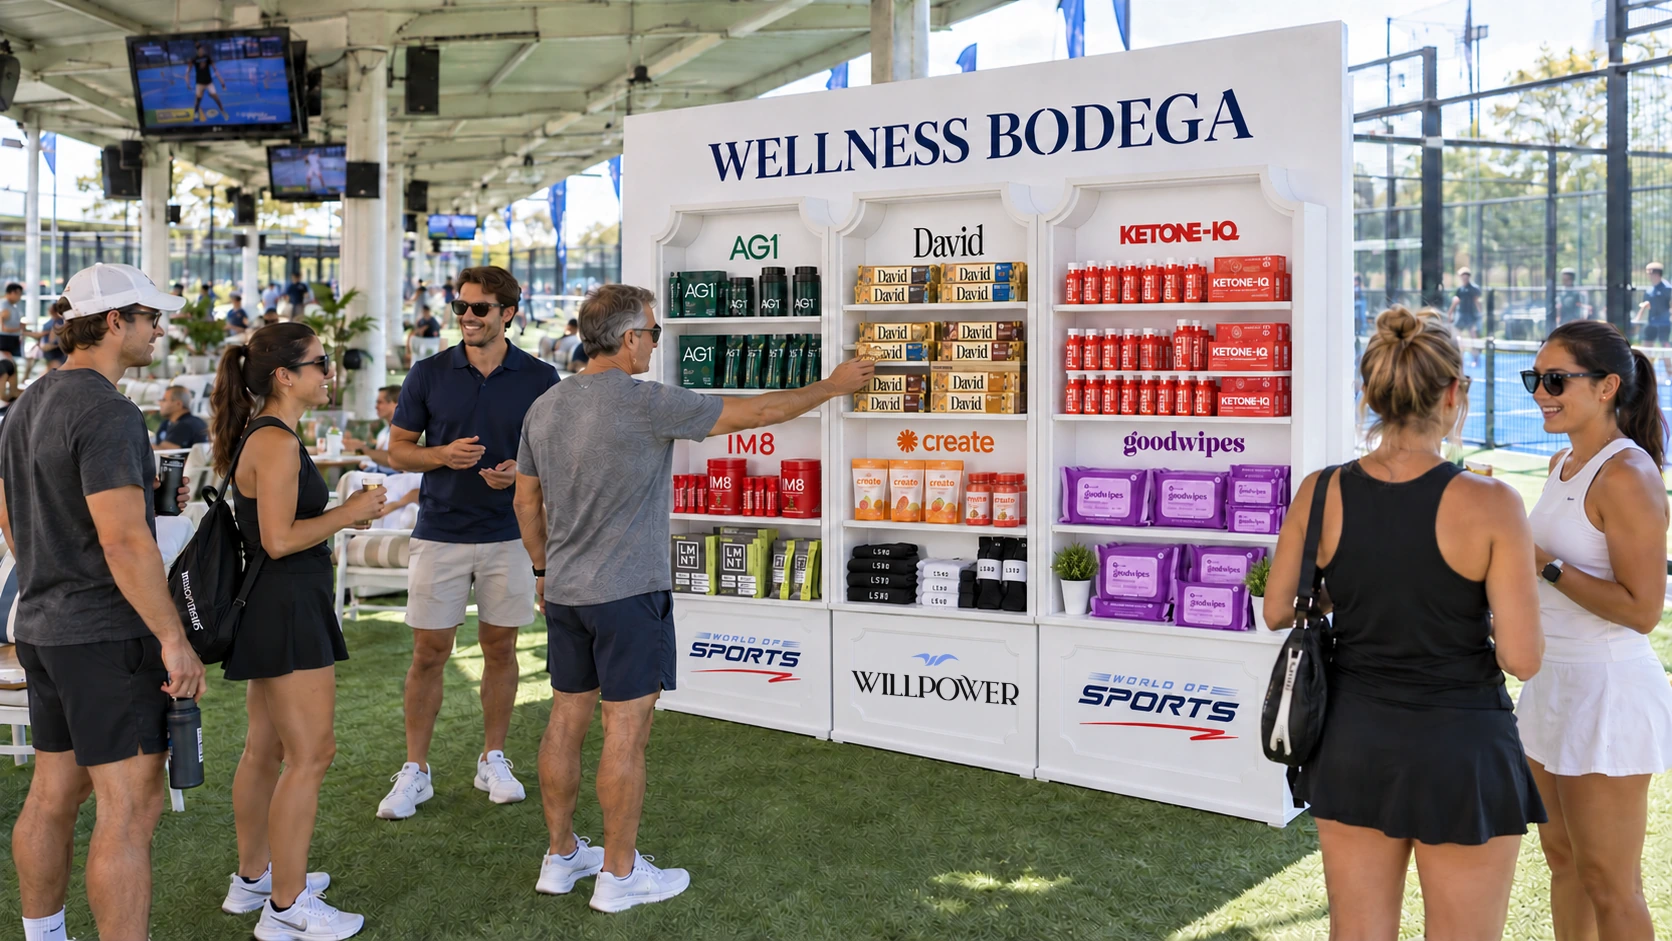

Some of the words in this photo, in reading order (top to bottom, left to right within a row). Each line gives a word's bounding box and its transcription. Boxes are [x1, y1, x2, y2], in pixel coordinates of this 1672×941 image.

[708, 117, 970, 182] WELLNESS
[986, 88, 1253, 160] BODEGA
[1120, 220, 1240, 245] KETONE-IQ
[729, 233, 778, 261] AG1
[913, 224, 984, 258] David
[878, 269, 907, 283] David
[960, 266, 990, 281] David
[1213, 277, 1269, 288] KETONE-IQ
[685, 283, 714, 298] AG1
[874, 287, 905, 302] David
[957, 285, 988, 301] David
[878, 325, 907, 340] David
[962, 324, 992, 339] David
[683, 346, 714, 362] AG1
[956, 344, 988, 359] David
[1212, 347, 1268, 357] KETONE-IQ
[873, 376, 902, 391] David
[953, 374, 984, 390] David
[871, 395, 900, 410] David
[951, 396, 982, 410] David
[1221, 396, 1270, 406] KETONE-IQ
[728, 432, 775, 456] IM8
[922, 430, 995, 453] create
[1123, 430, 1245, 458] goodwipes
[710, 476, 732, 490] IM8
[782, 478, 805, 492] IM8
[680, 544, 695, 555] LM
[727, 547, 742, 557] LM
[680, 555, 695, 565] NT
[726, 558, 742, 568] NT
[712, 633, 757, 644] WORLD
[762, 639, 782, 647] OF
[689, 642, 801, 668] SPORTS
[851, 670, 1019, 706] WILLPOWER
[1112, 674, 1175, 690] WORLD
[1184, 683, 1210, 693] OF
[1078, 684, 1240, 723] SPORTS
